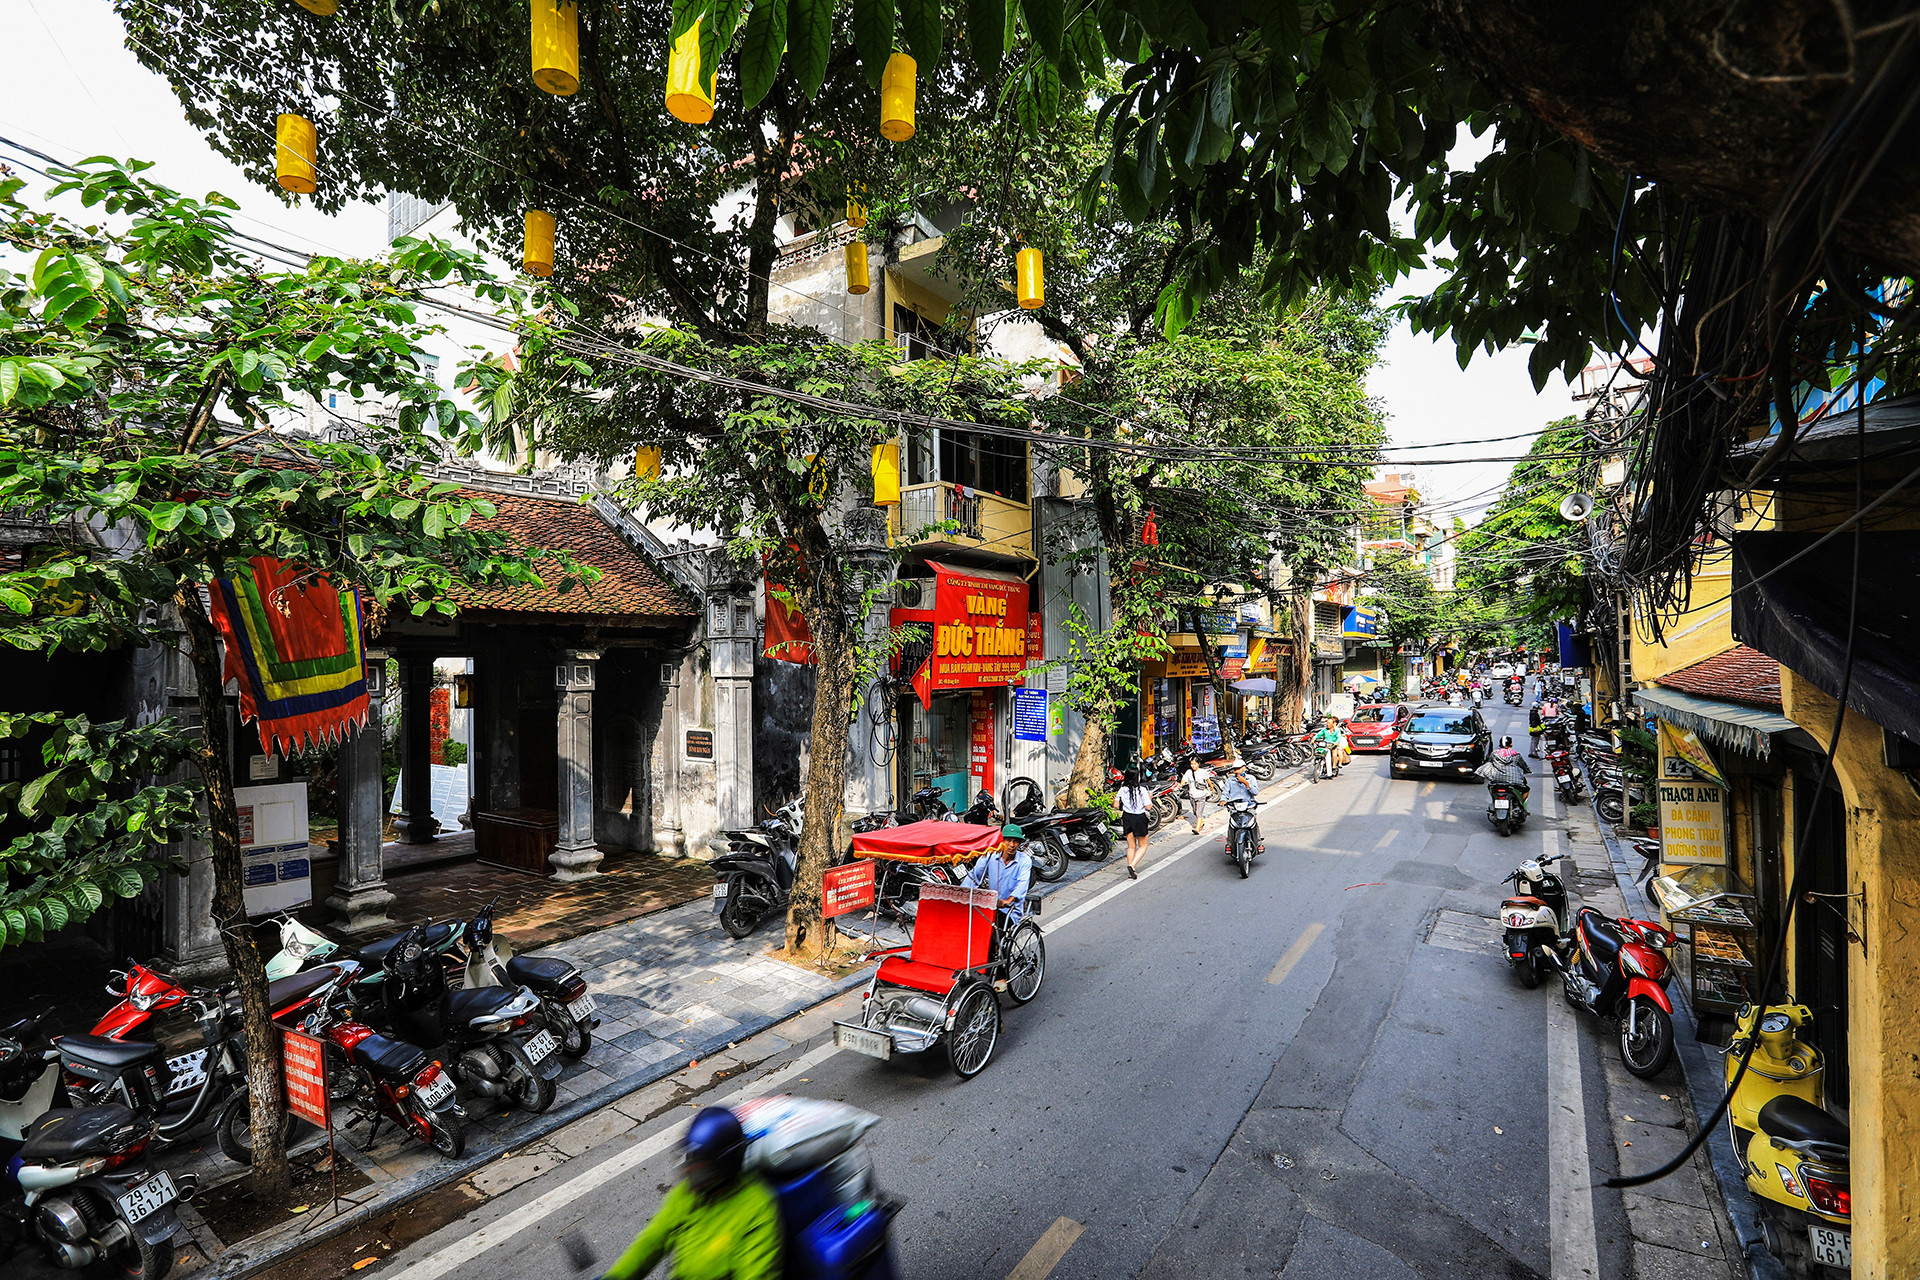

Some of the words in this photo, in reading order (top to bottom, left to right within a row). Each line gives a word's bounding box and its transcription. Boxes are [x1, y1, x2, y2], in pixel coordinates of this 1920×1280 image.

[966, 592, 1007, 616] VÀNG
[937, 619, 973, 656] ĐỨC
[975, 620, 1024, 656] THẮNG
[1660, 787, 1694, 805] THẠCH
[1697, 788, 1719, 802] ANH
[1671, 806, 1683, 822] ĐÁ
[1686, 806, 1711, 822] CẢNH
[1665, 827, 1695, 840] PHONG
[1666, 841, 1698, 856] DƯỠNG
[1700, 844, 1722, 858] SINH
[574, 1002, 593, 1018] 5591
[527, 1034, 548, 1053] 29-G1
[426, 1080, 439, 1092] 29
[126, 1177, 164, 1207] 29-G1
[128, 1186, 173, 1222] 361.71
[1816, 1246, 1851, 1266] 461.
